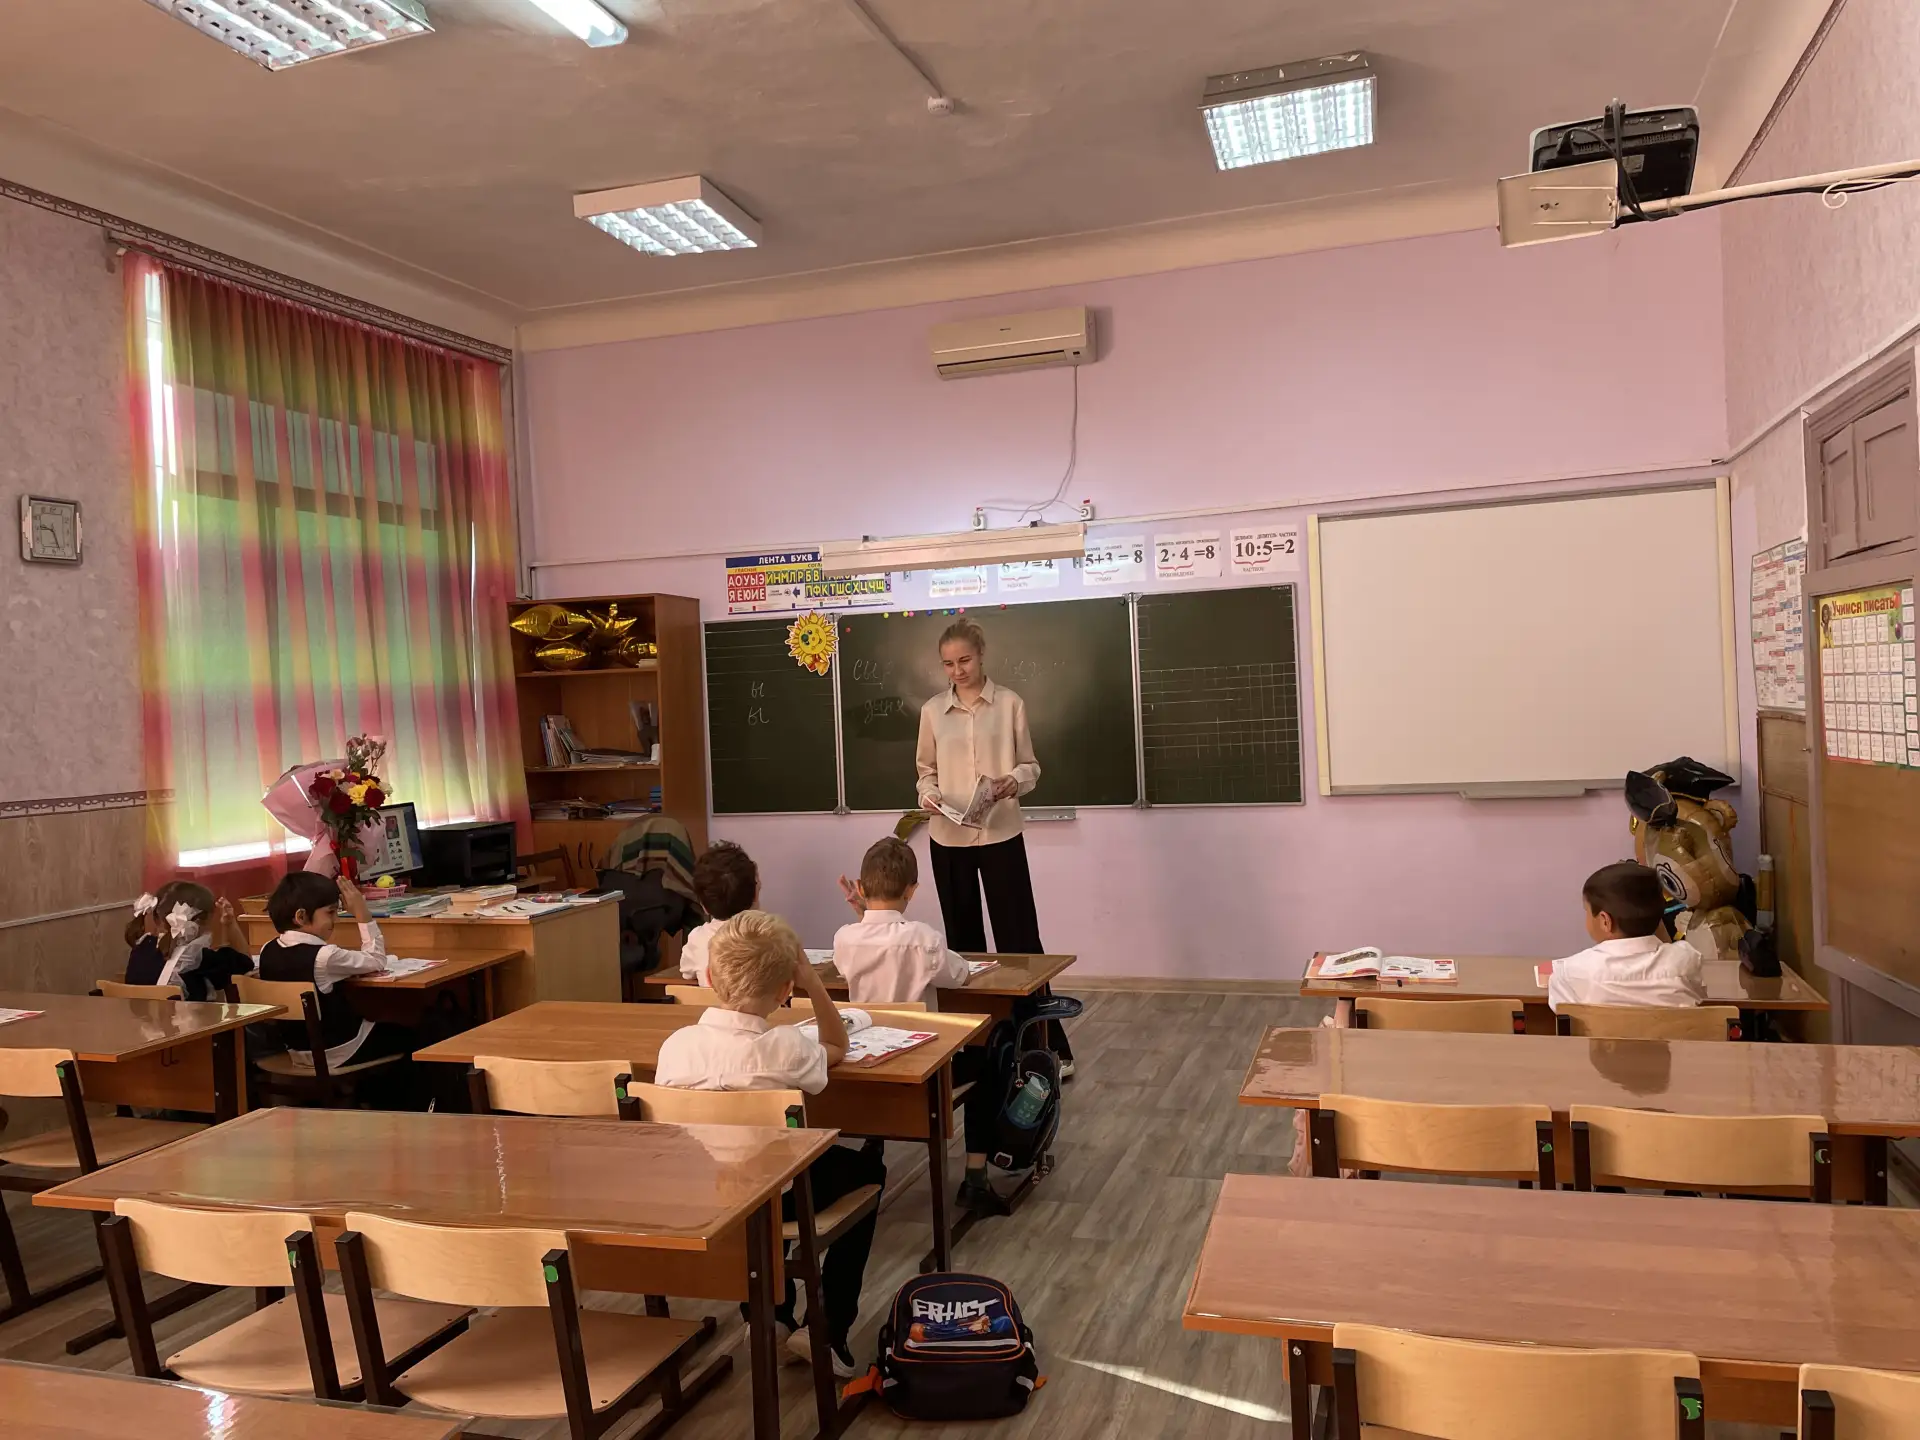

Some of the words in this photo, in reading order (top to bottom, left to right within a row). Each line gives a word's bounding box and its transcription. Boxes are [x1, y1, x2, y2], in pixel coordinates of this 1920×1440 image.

[758, 555, 786, 565] ЛЕНТА
[790, 553, 813, 563] БУКВ
[1832, 600, 1862, 616] Учимся
[1863, 597, 1895, 613] писать
